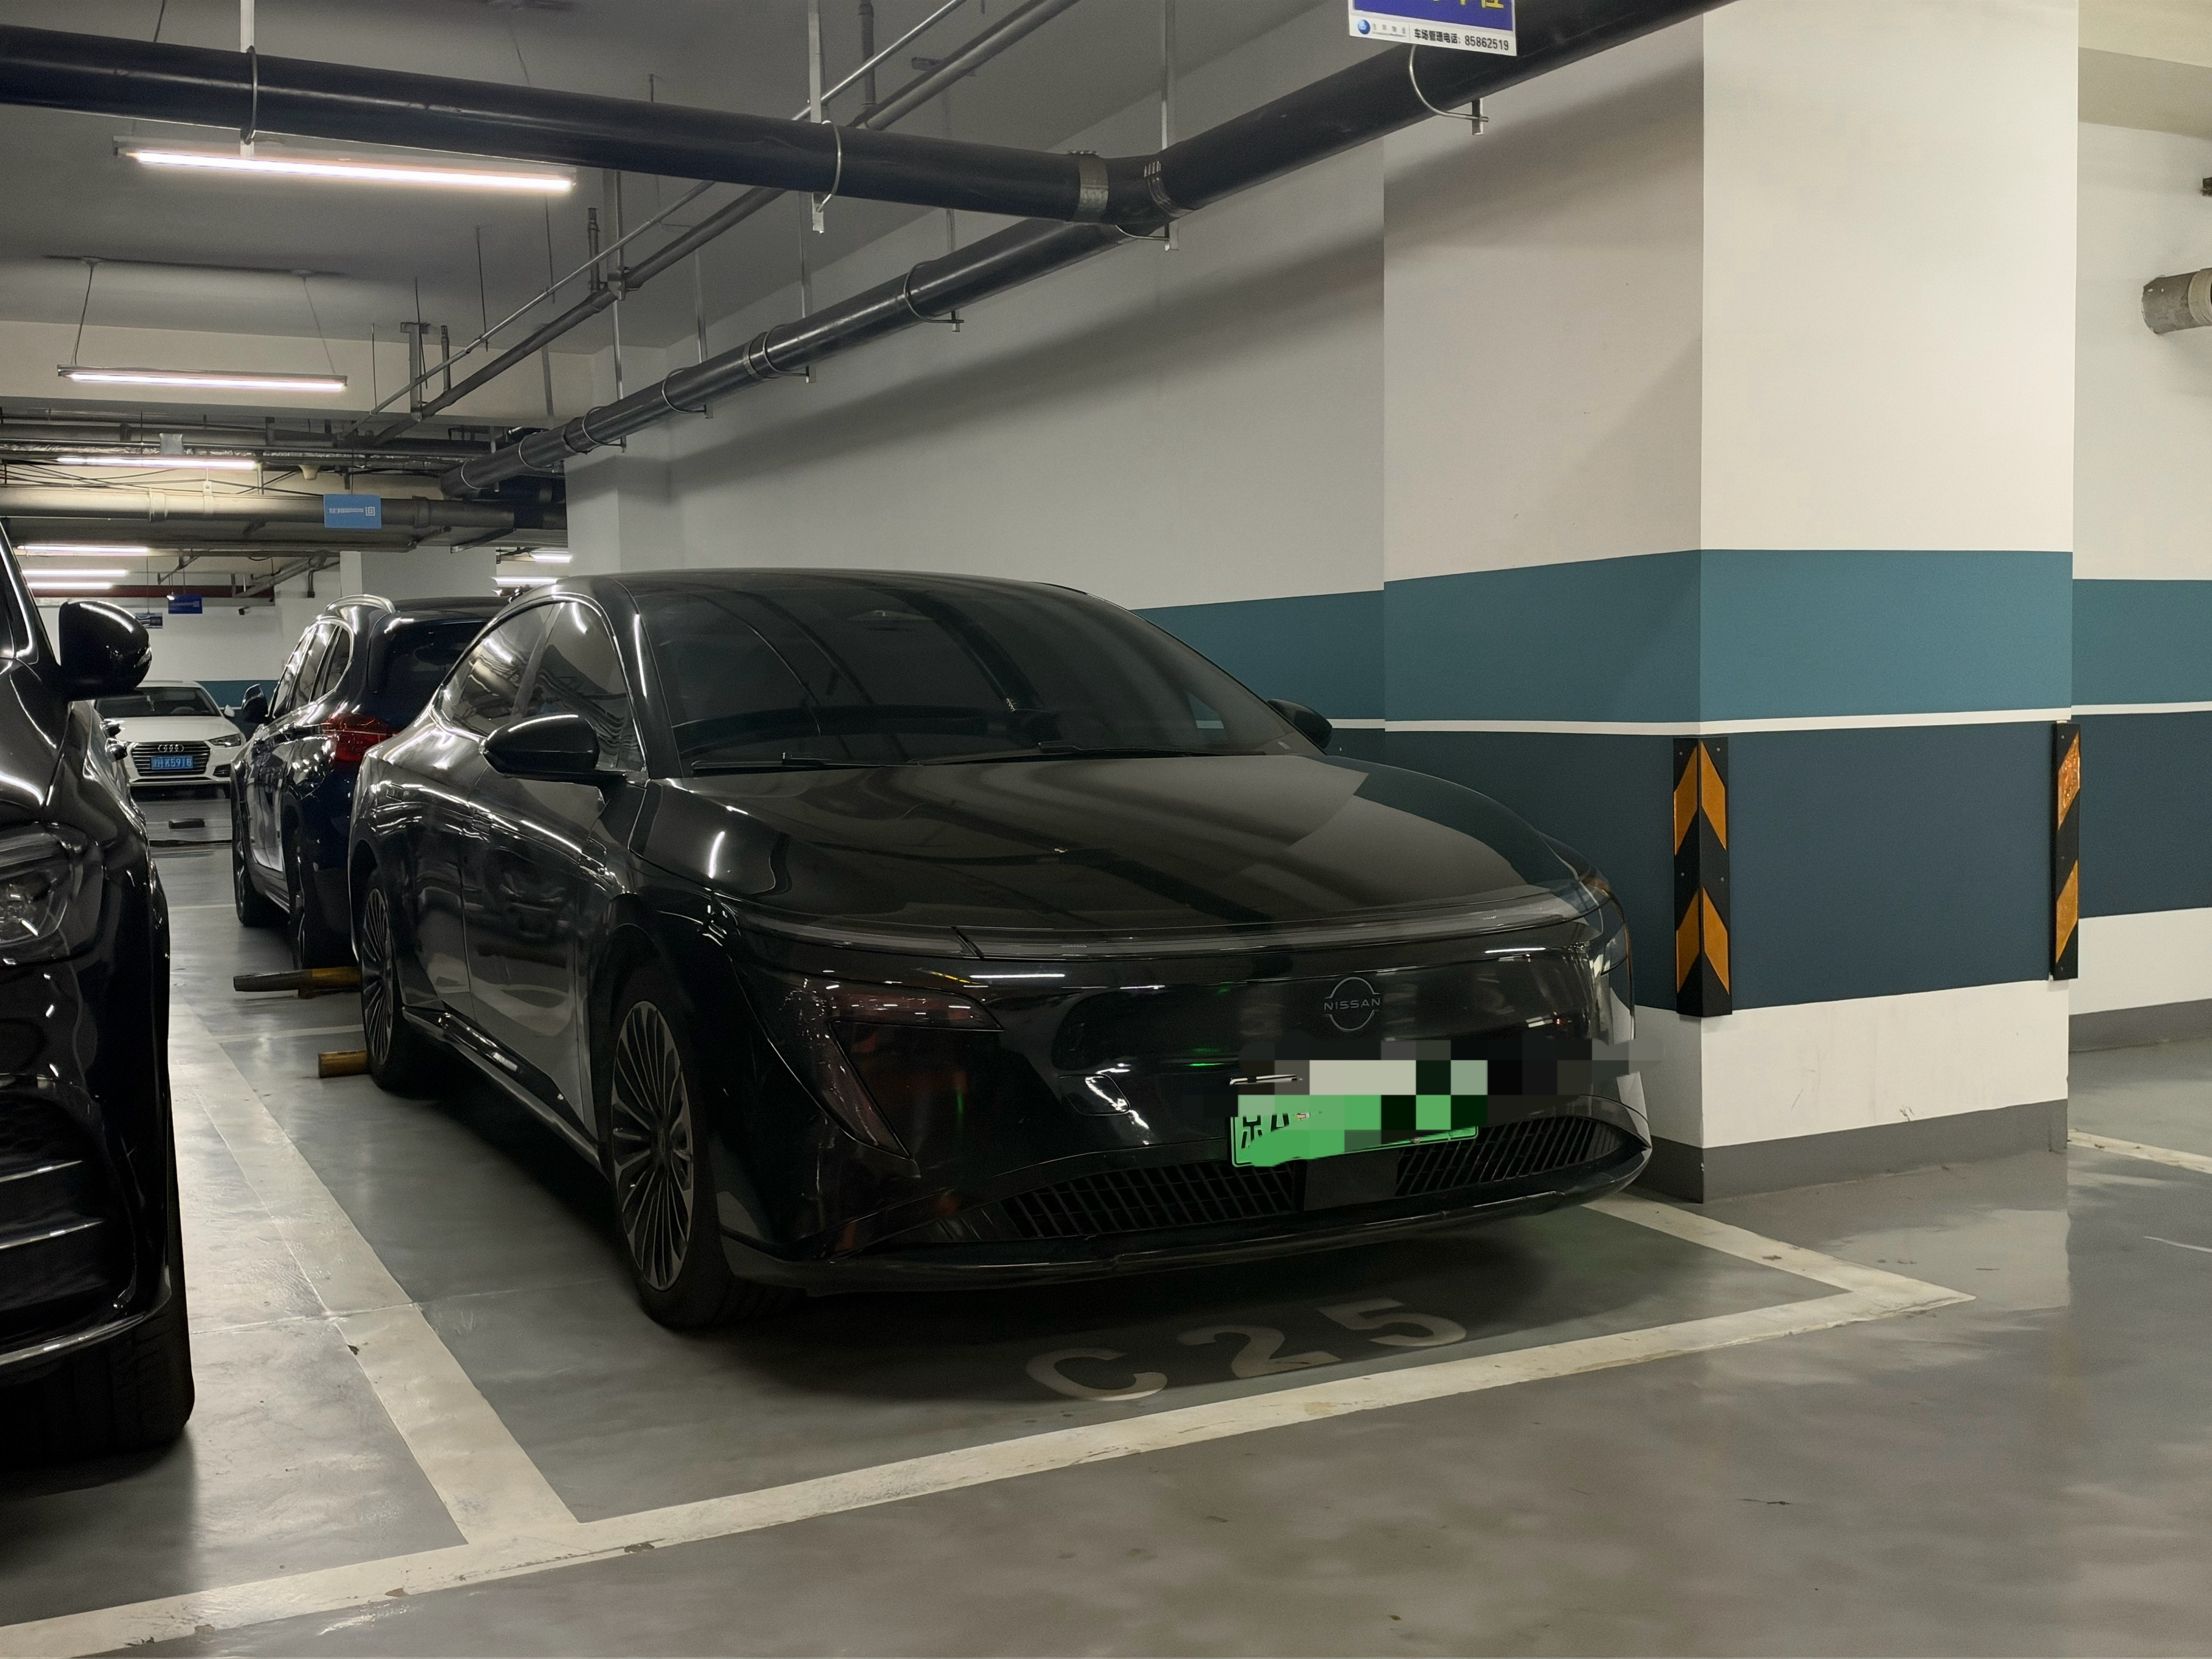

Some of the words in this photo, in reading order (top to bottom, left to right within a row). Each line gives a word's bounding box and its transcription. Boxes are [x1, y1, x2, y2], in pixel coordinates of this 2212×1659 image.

[1465, 35, 1509, 50] 85862519
[1324, 997, 1380, 1011] NISSAN
[1026, 1298, 1467, 1401] C25
